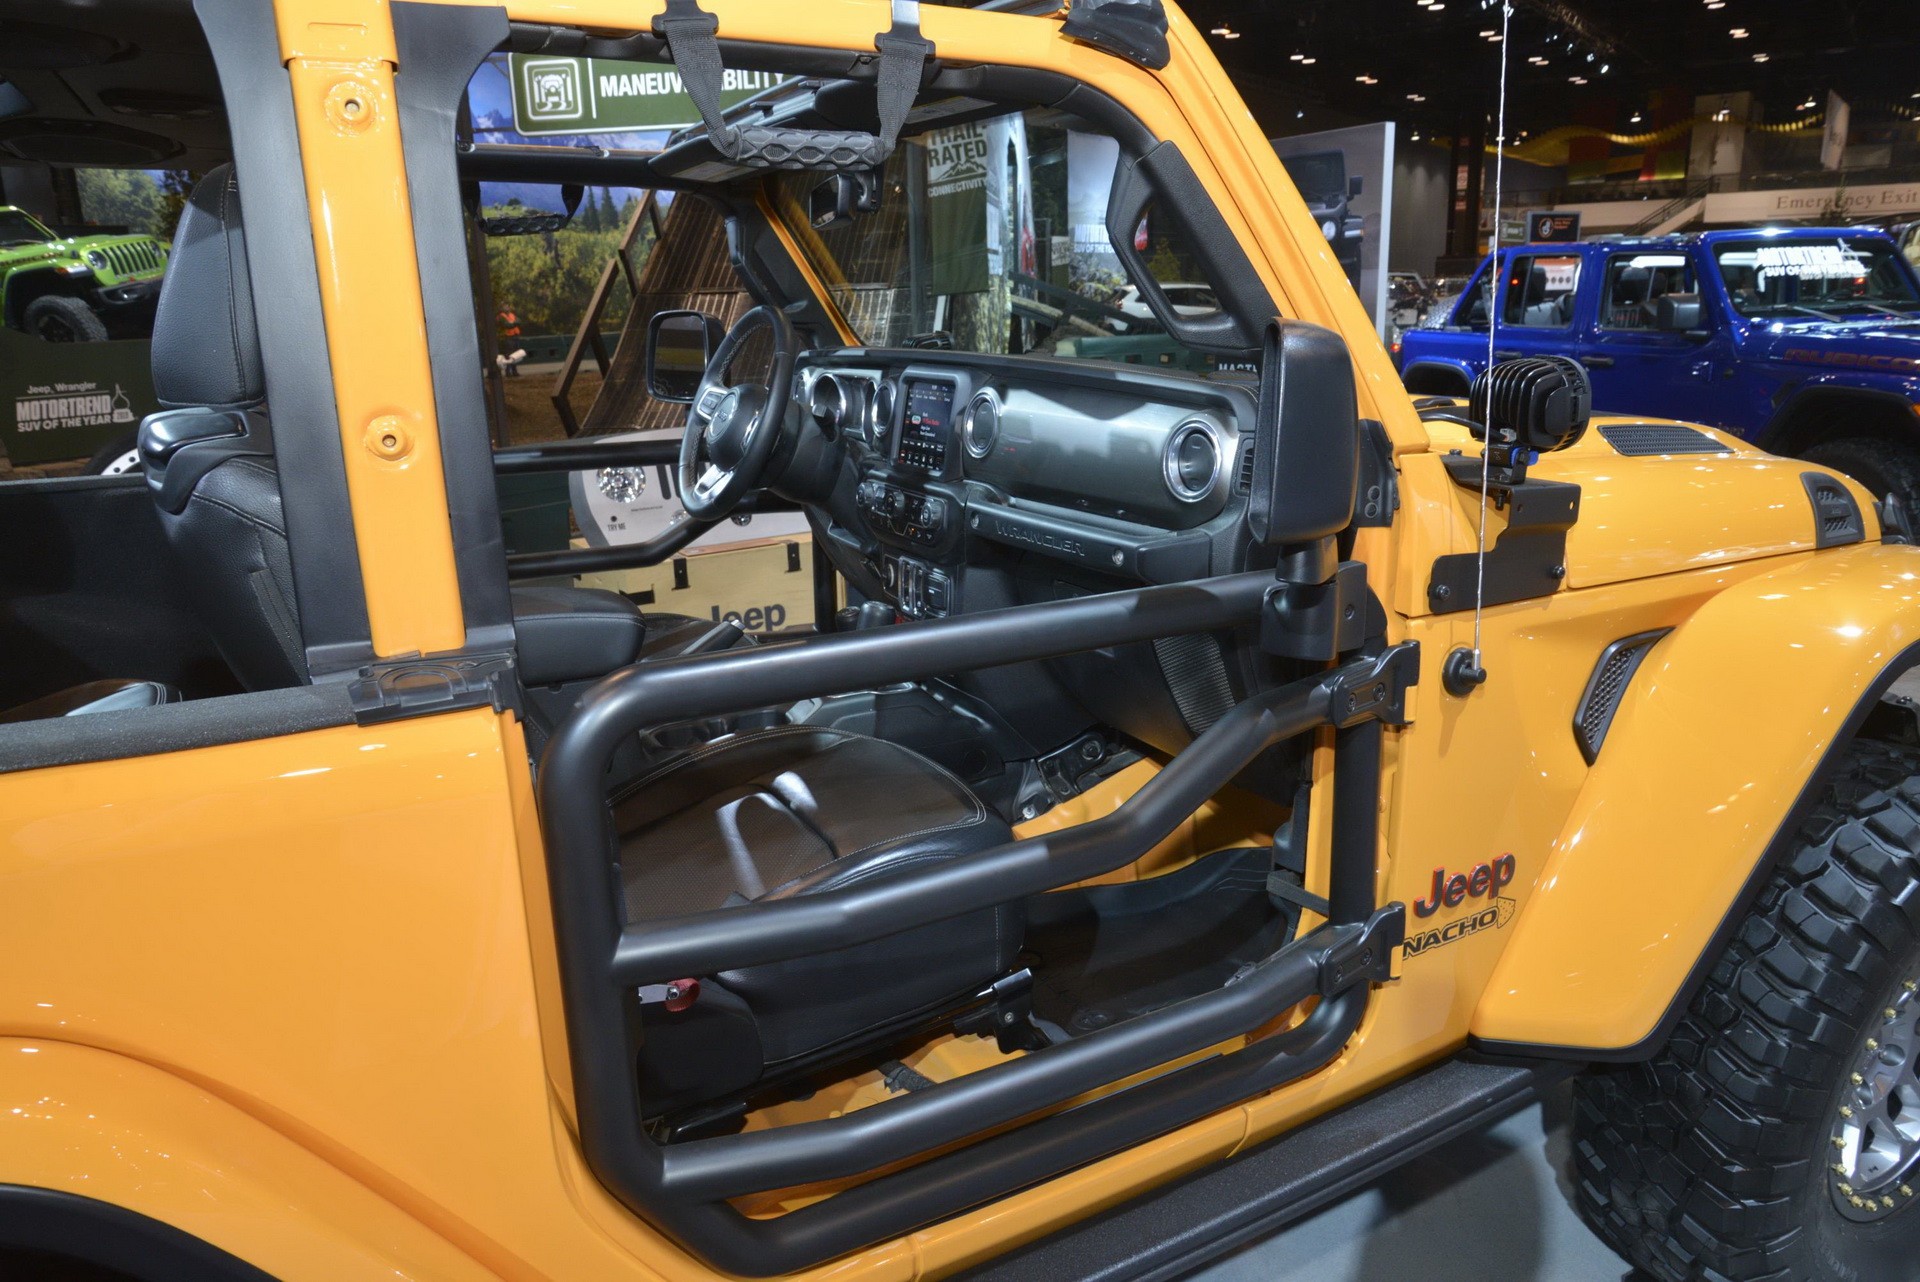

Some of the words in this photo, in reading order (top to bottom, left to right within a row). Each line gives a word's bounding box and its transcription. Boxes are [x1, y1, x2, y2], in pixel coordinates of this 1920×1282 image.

[600, 69, 786, 98] MANEUVBILITY
[928, 139, 988, 168] RATED
[928, 178, 987, 198] CONNECTIVITY
[1881, 189, 1918, 205] Exit
[1765, 266, 1786, 277] SUV
[1786, 265, 1800, 276] OF
[27, 385, 52, 394] Jeep
[55, 382, 97, 392] Wrangler
[16, 395, 111, 421] MOTORTREND
[17, 421, 41, 432] SUV
[42, 420, 59, 430] OF
[61, 418, 82, 428] THE
[82, 414, 112, 426] YEAR
[608, 523, 618, 532] TRY
[618, 522, 626, 531] ME
[995, 520, 1085, 557] WRANGLER
[1414, 851, 1516, 919] Jeep
[1402, 905, 1499, 961] NACHO
